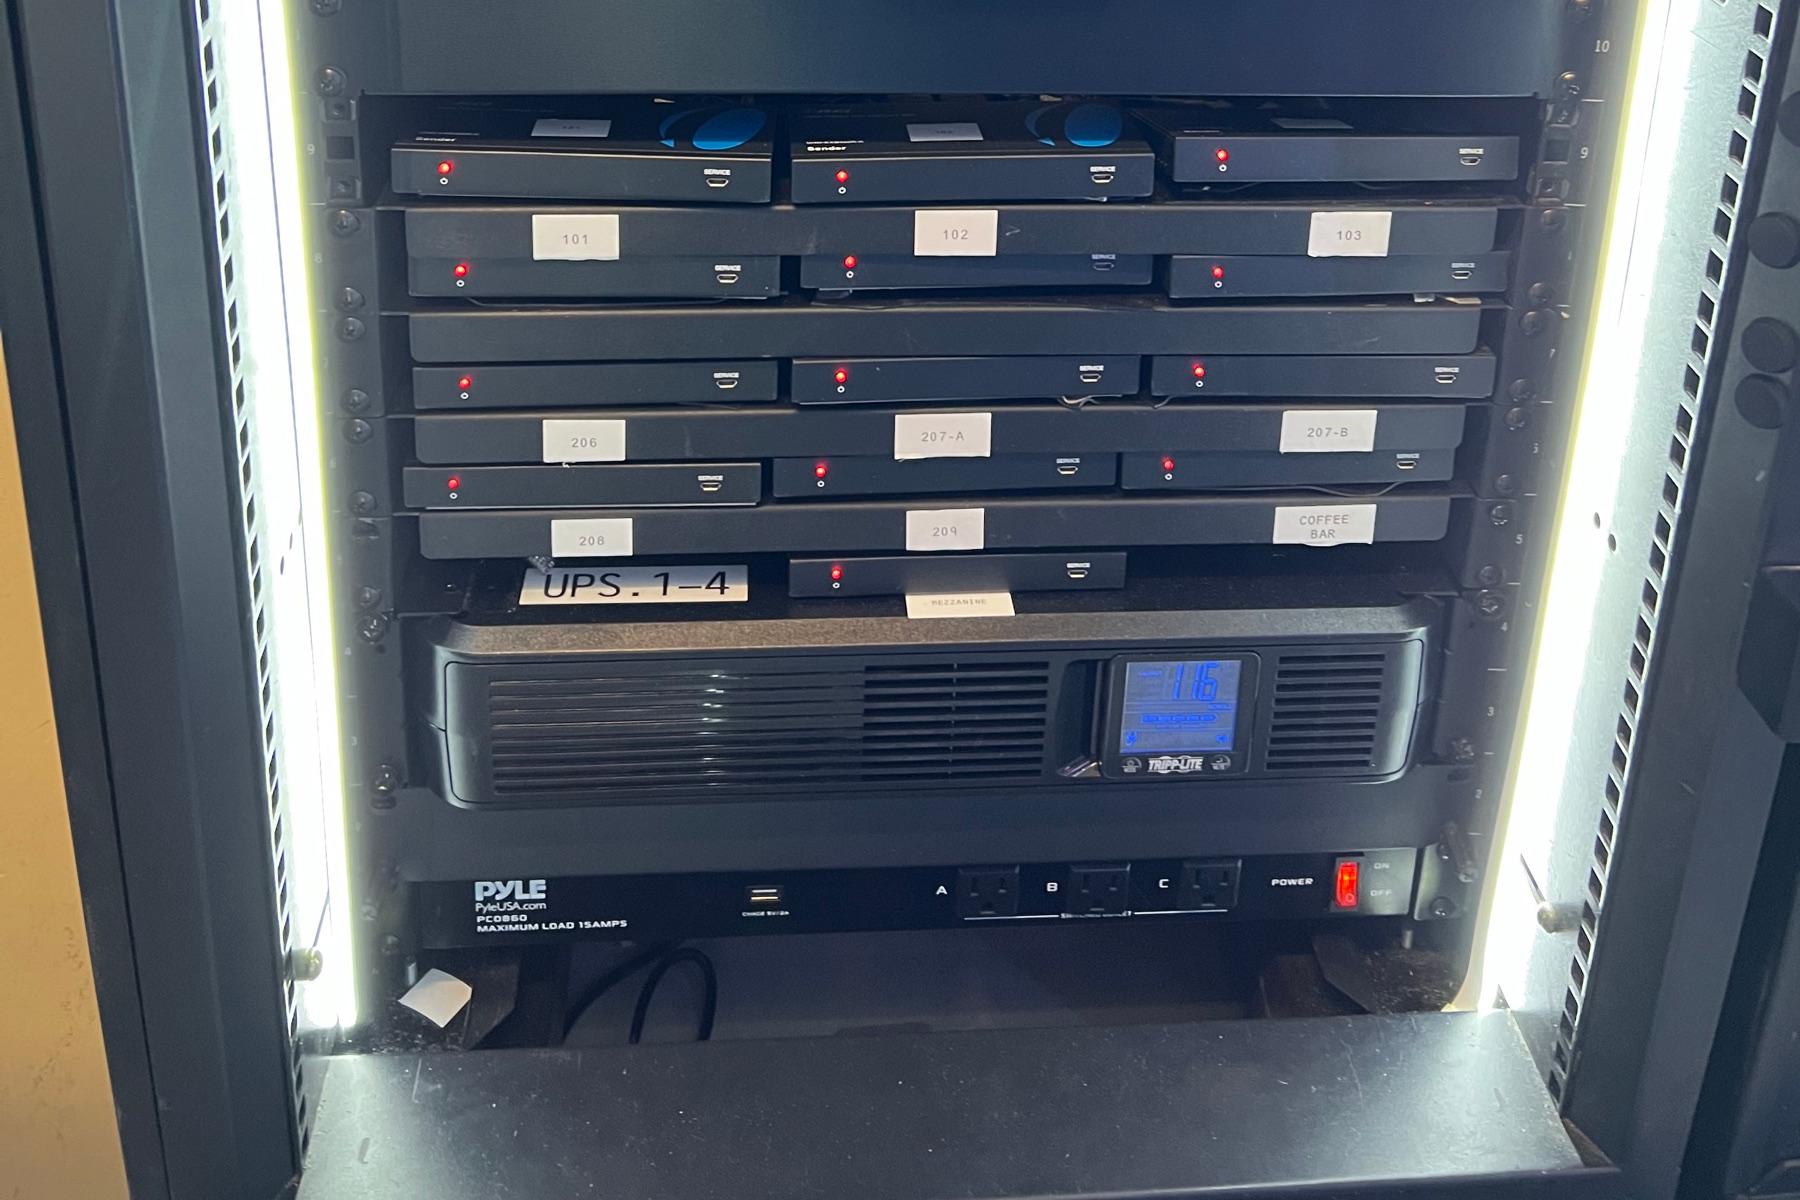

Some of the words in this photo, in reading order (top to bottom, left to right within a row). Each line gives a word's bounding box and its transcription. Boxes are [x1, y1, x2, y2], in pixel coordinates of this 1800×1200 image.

[1594, 39, 1611, 53] 10
[1579, 146, 1589, 159] 9
[562, 233, 588, 245] 101
[943, 228, 969, 241] 102
[1337, 229, 1362, 241] 103
[921, 431, 965, 443] 207-A
[1306, 426, 1349, 438] 207-B
[571, 437, 598, 449] 206
[1298, 513, 1350, 526] COFFEE
[932, 525, 958, 537] 209
[1310, 528, 1336, 540] BAR
[578, 535, 605, 547] 208
[1515, 533, 1524, 545] 5
[1172, 662, 1219, 701] 116
[1374, 862, 1390, 870] ON
[1046, 882, 1058, 892] B
[1158, 878, 1170, 889] C
[1271, 877, 1314, 886] POWER
[935, 885, 948, 895] A
[1370, 889, 1392, 897] OFF
[475, 901, 547, 914] PyleUSA.com
[476, 923, 540, 933] MAXIMUM
[541, 921, 575, 930] LOAD
[578, 919, 628, 929] 15AMPS
